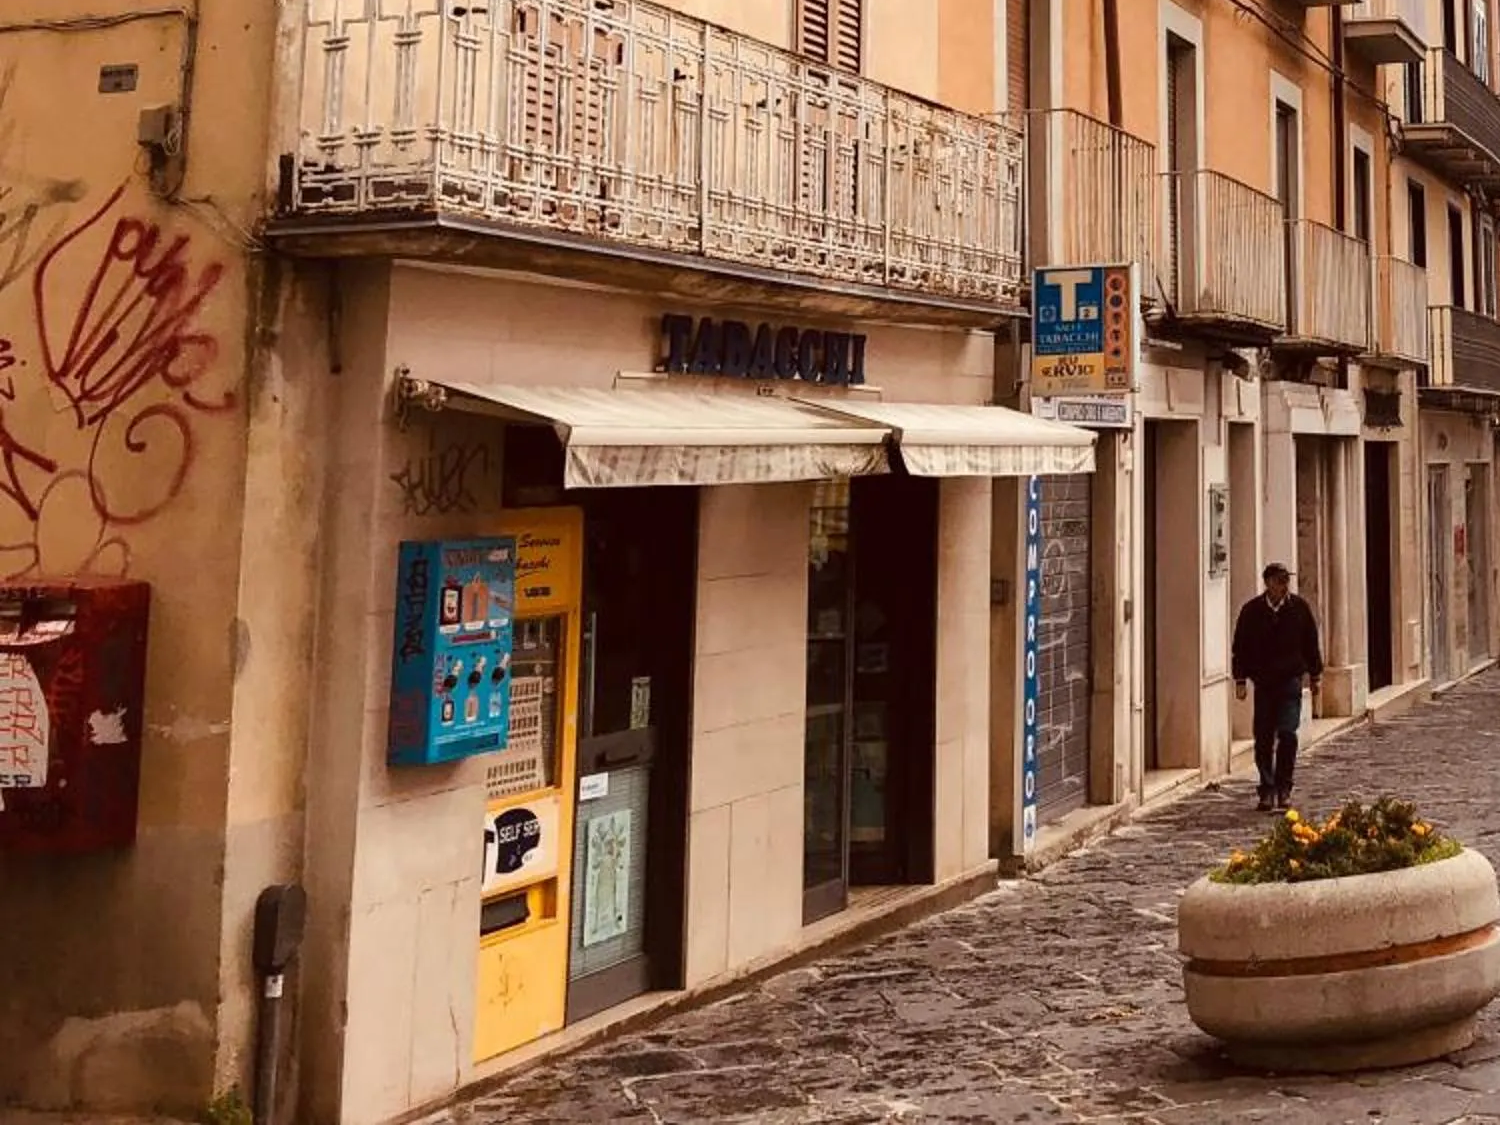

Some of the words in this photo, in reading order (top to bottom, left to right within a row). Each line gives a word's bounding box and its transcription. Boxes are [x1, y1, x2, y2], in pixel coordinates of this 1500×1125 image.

[1039, 329, 1099, 345] TABACCHI
[660, 313, 866, 385] TABACCHI
[499, 824, 522, 844] SELF
